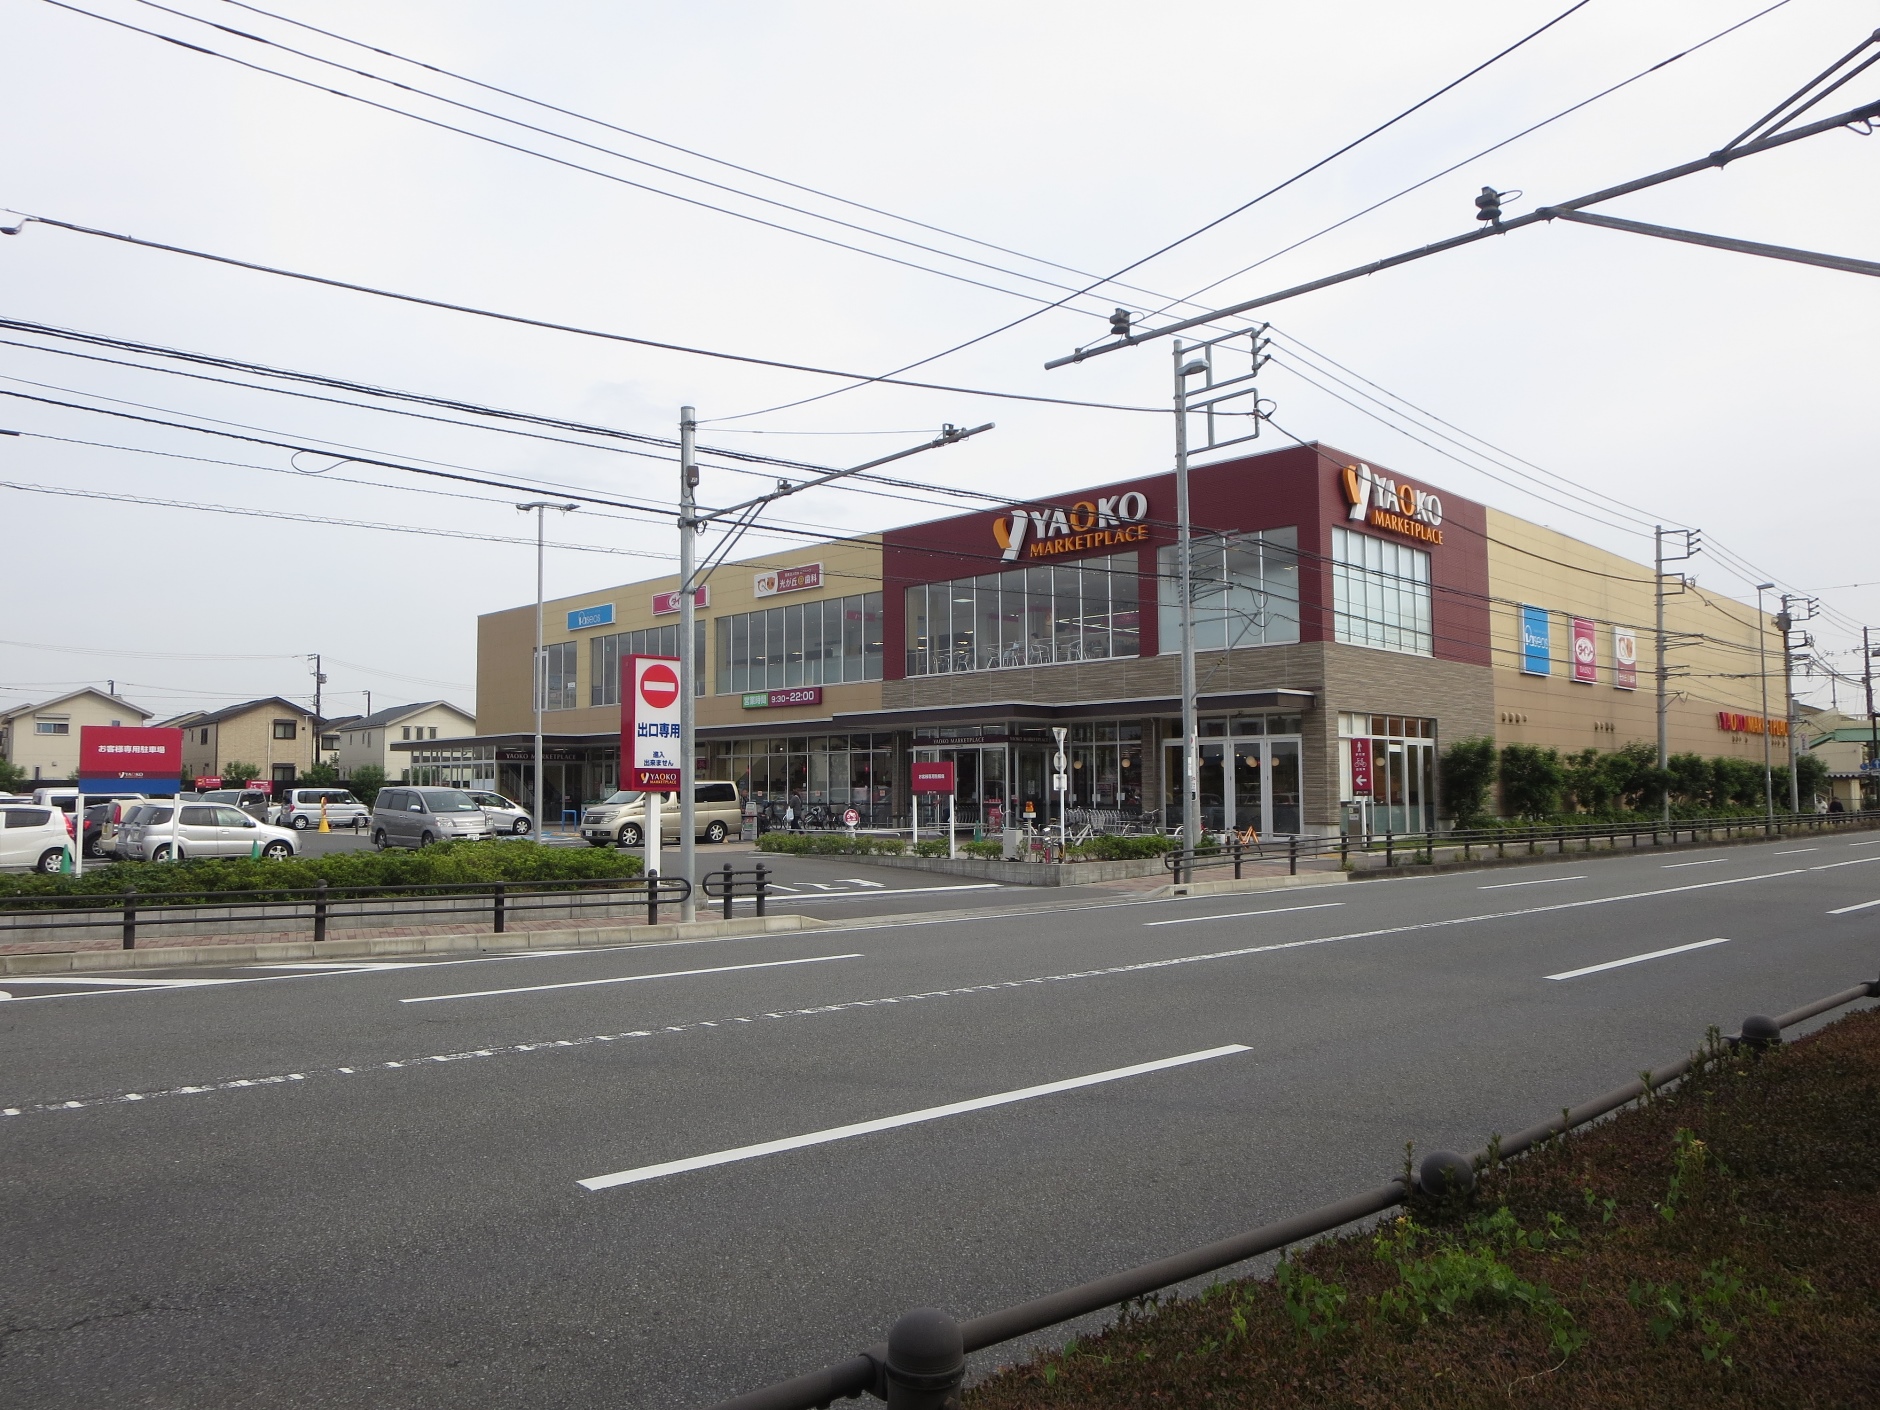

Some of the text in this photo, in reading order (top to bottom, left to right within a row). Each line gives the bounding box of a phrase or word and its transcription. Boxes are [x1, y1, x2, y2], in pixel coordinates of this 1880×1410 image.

[1372, 473, 1442, 525] YAOKO
[1029, 491, 1148, 539] YAOKO
[1372, 510, 1443, 545] MARKETPLACE
[1029, 524, 1149, 558] MARKETPLACE
[771, 691, 815, 703] 9:30-22:00
[637, 722, 680, 739] 出口専用
[98, 745, 166, 754] お客様専用駐車場
[653, 751, 665, 759] 進入
[643, 759, 674, 767] 出来ません
[649, 773, 677, 781] YAOKO
